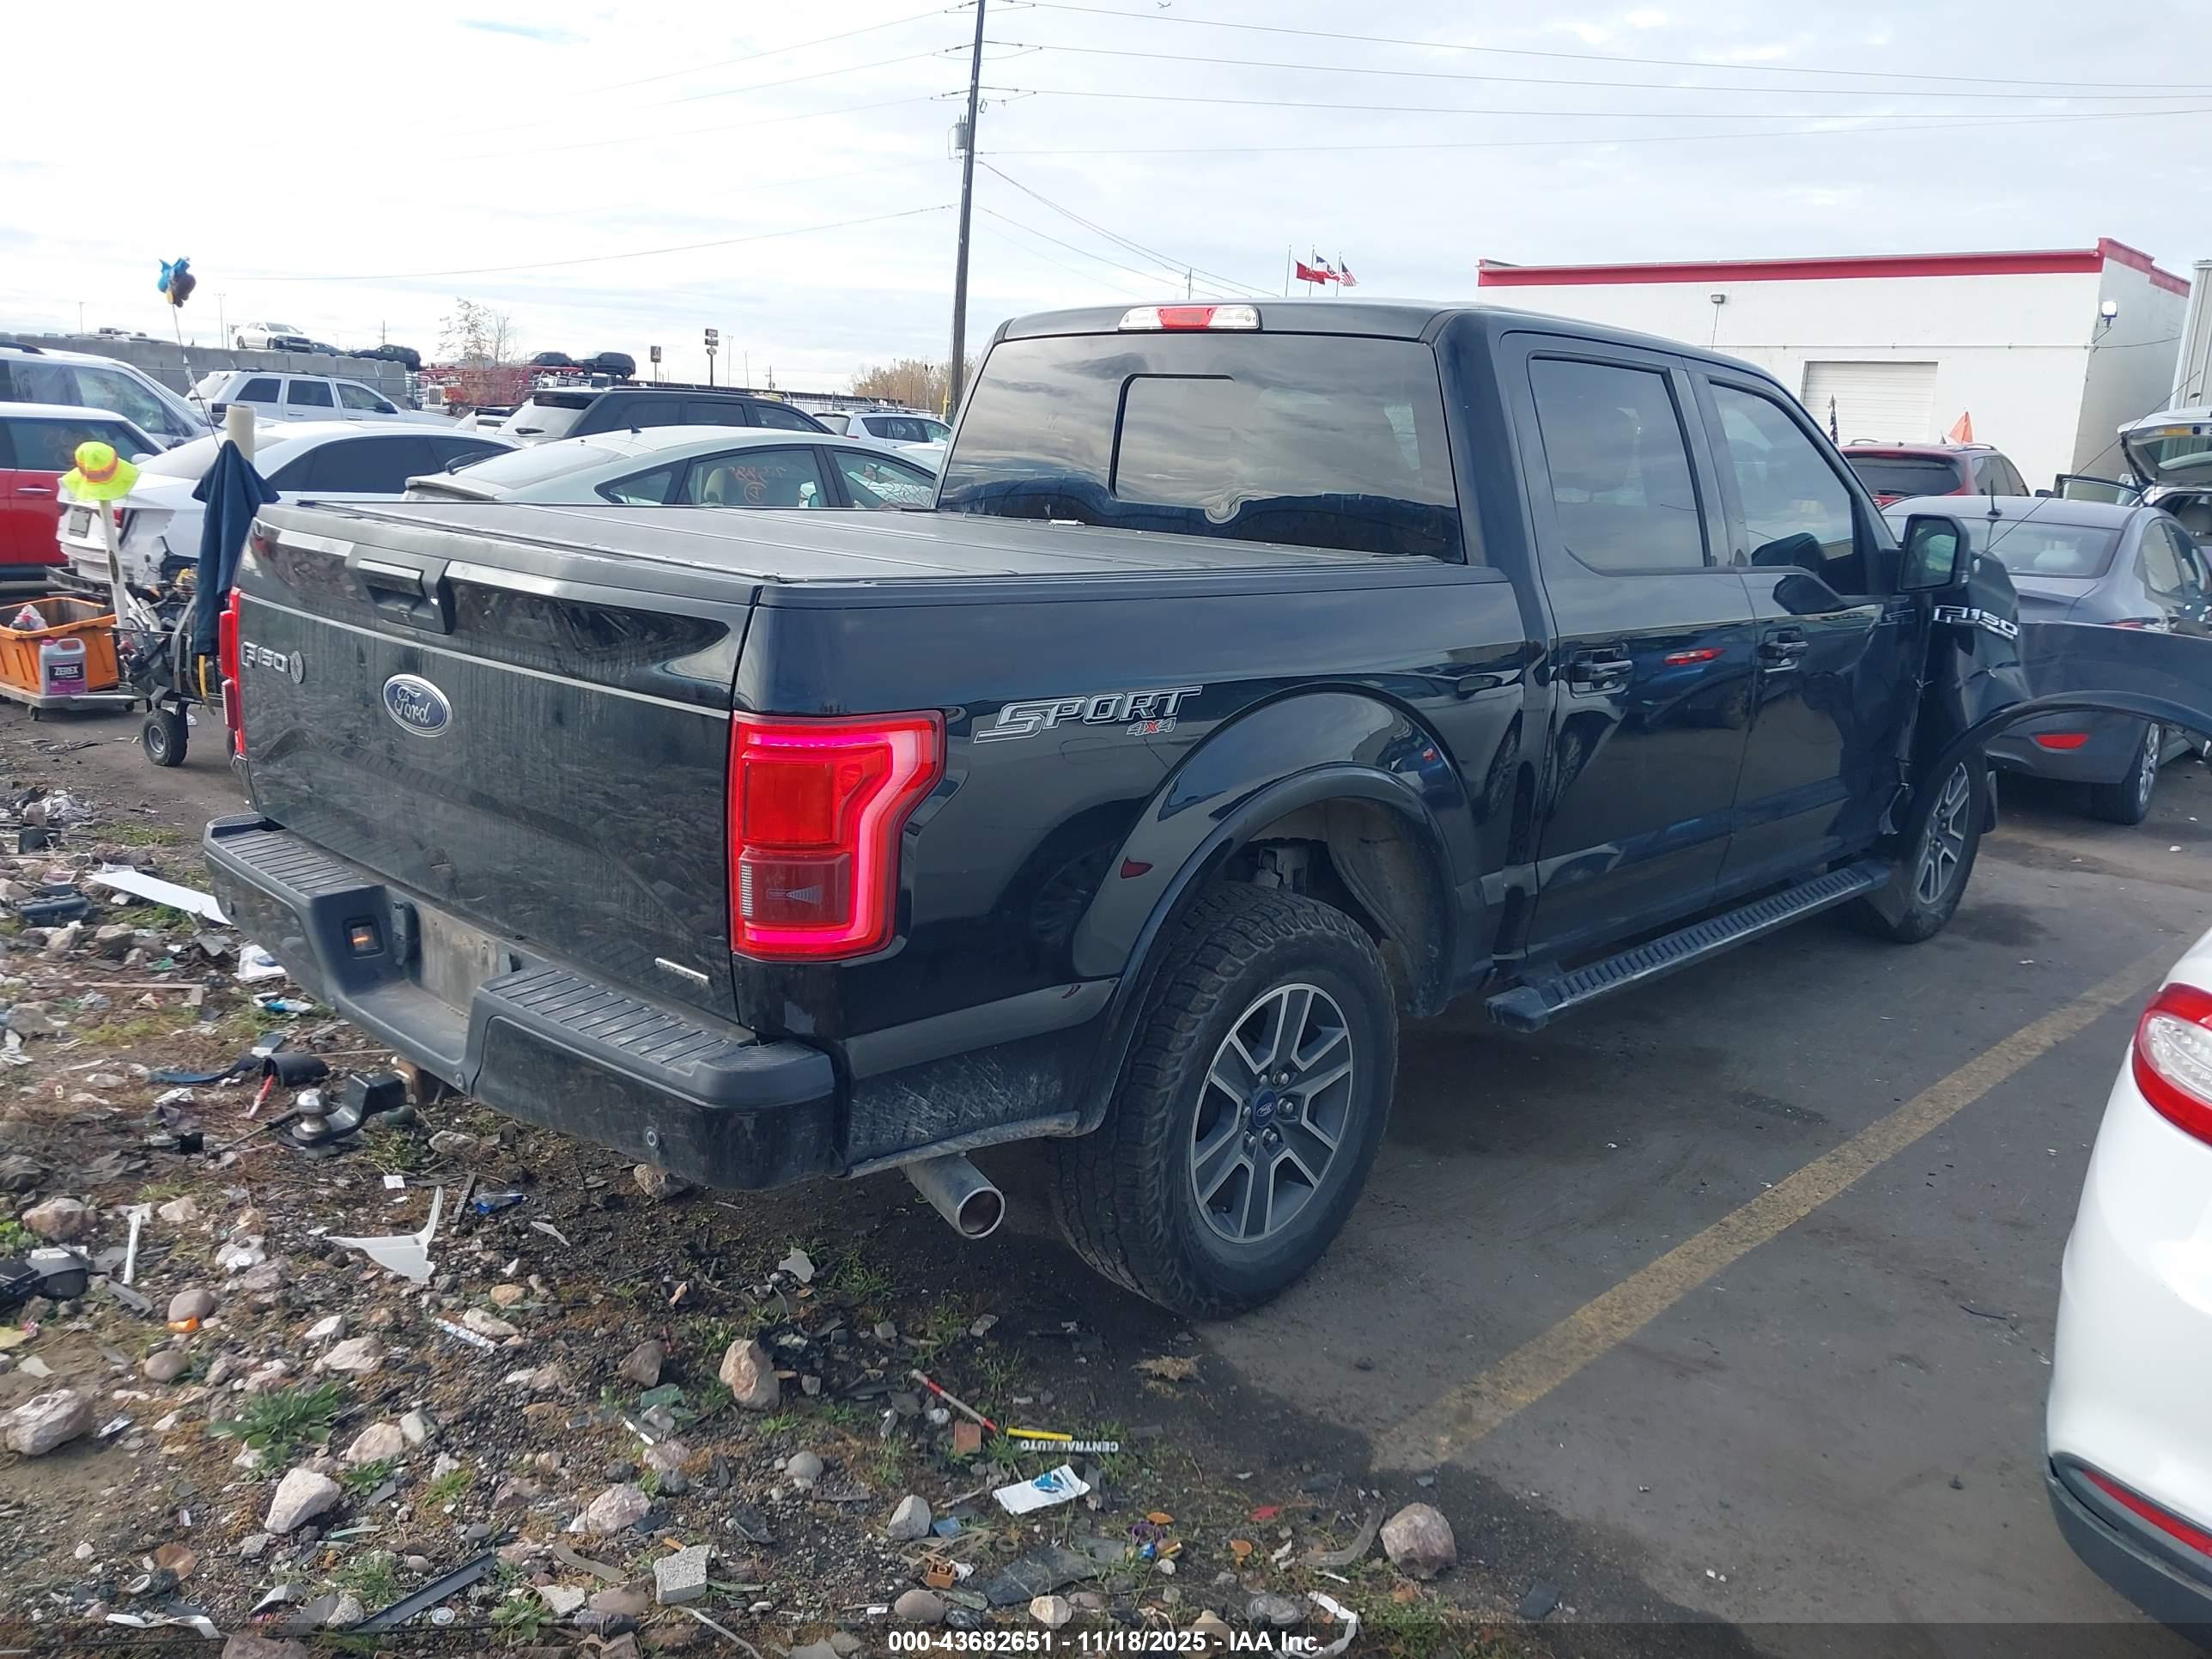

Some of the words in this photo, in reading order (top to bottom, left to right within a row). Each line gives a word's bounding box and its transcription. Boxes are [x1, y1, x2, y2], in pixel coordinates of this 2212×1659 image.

[394, 686, 431, 724] Ford
[974, 686, 1202, 744] SPORT
[1020, 1439, 1056, 1452] AUTO
